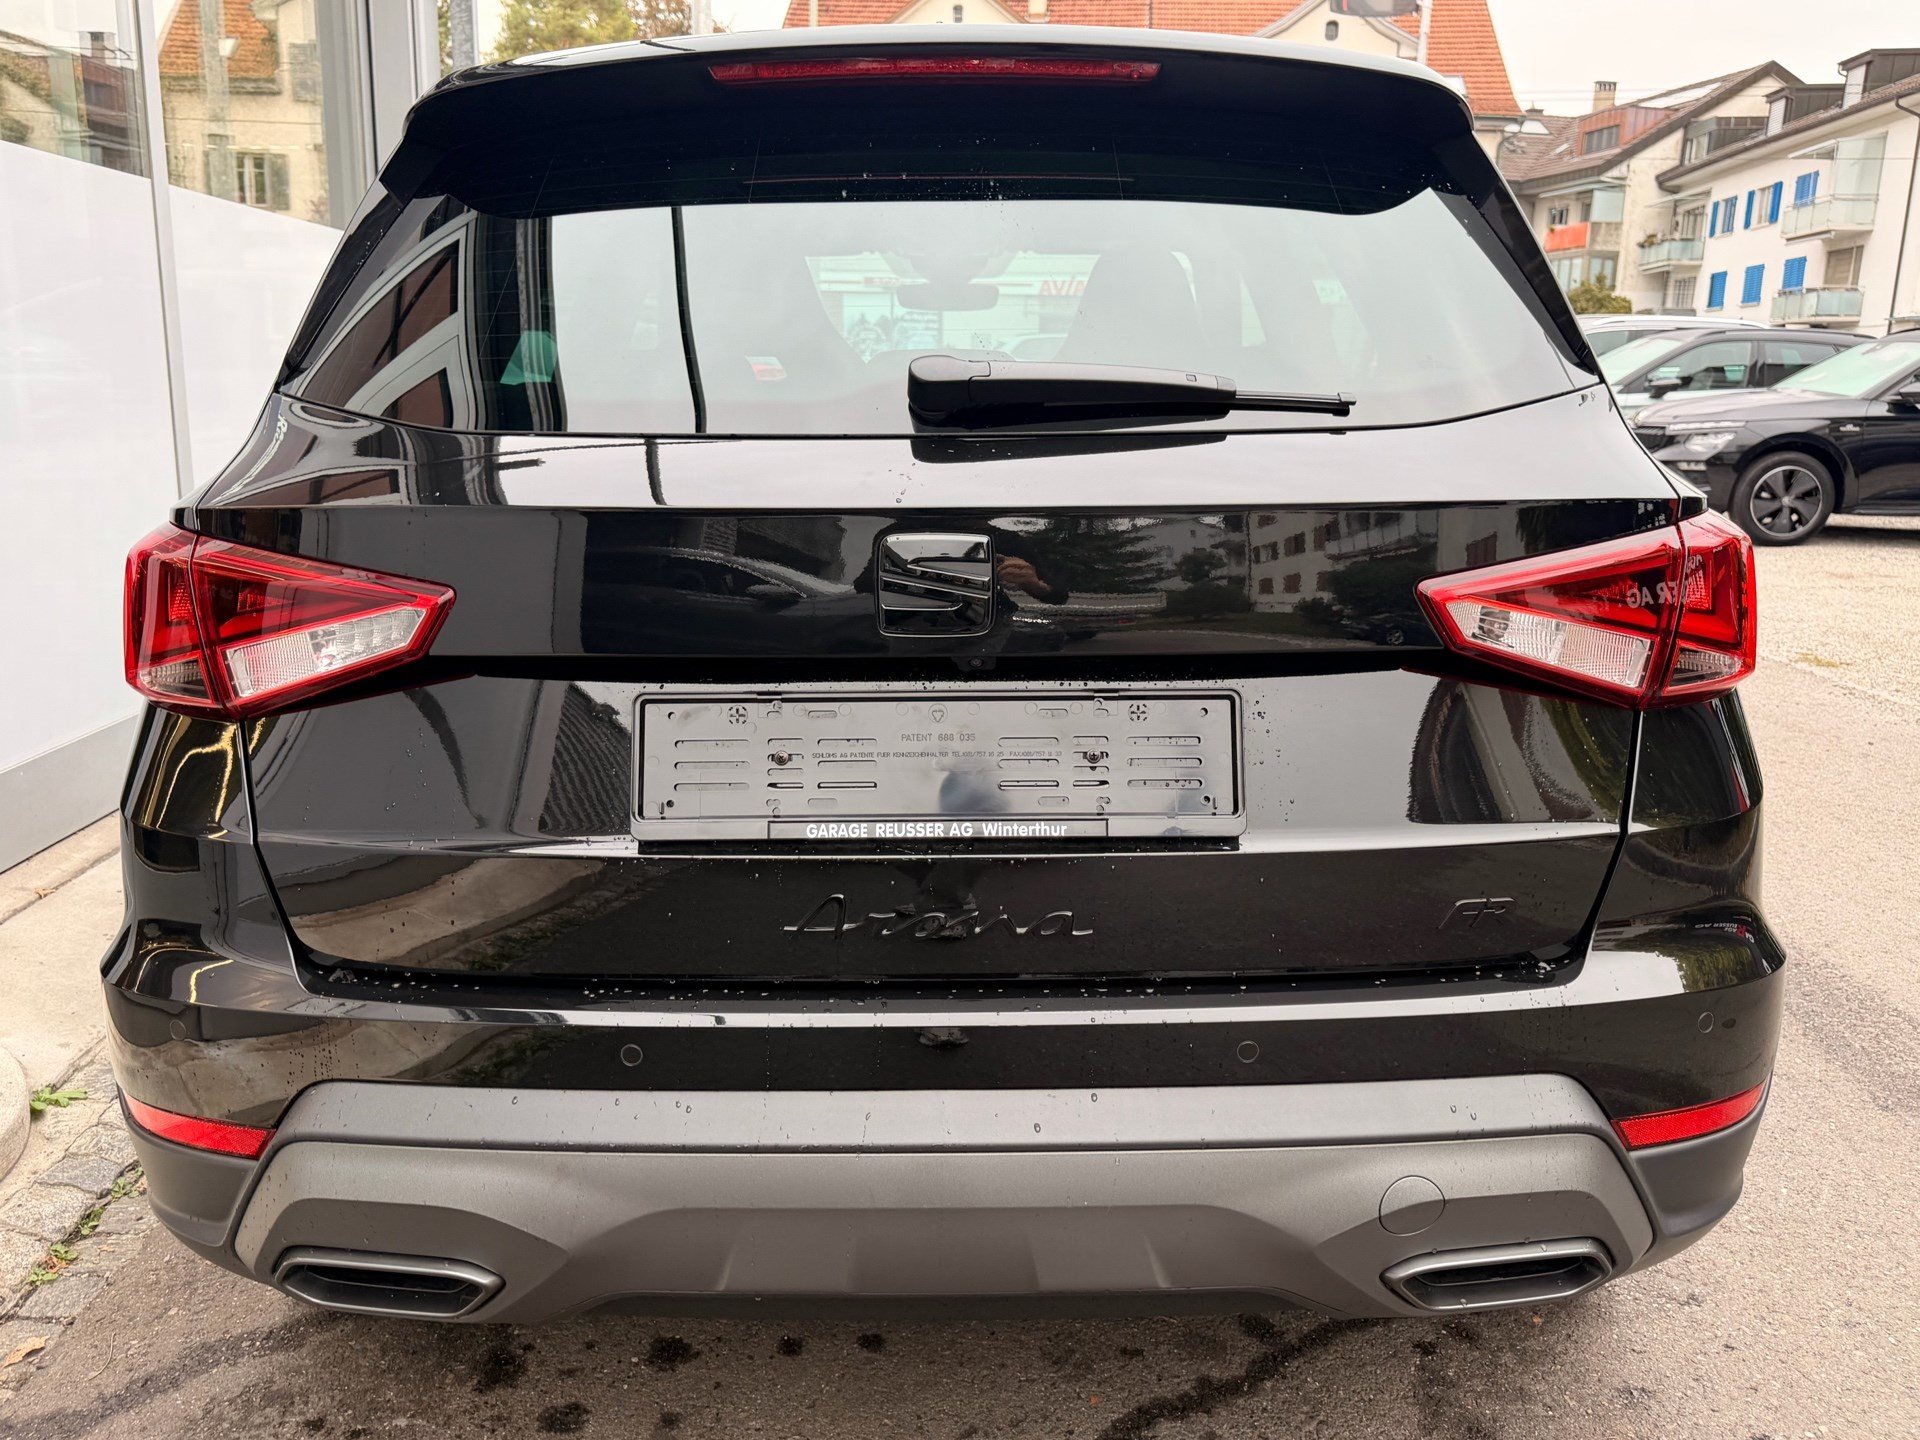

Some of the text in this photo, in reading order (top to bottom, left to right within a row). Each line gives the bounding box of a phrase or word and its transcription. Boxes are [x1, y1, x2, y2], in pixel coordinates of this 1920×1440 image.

[900, 732, 976, 742] PATENT 688 035
[849, 751, 875, 759] PATENTE
[806, 821, 1068, 838] GARAGE REUSSER AG Winterthur
[783, 893, 1094, 938] Arona
[1436, 897, 1516, 929] FR
